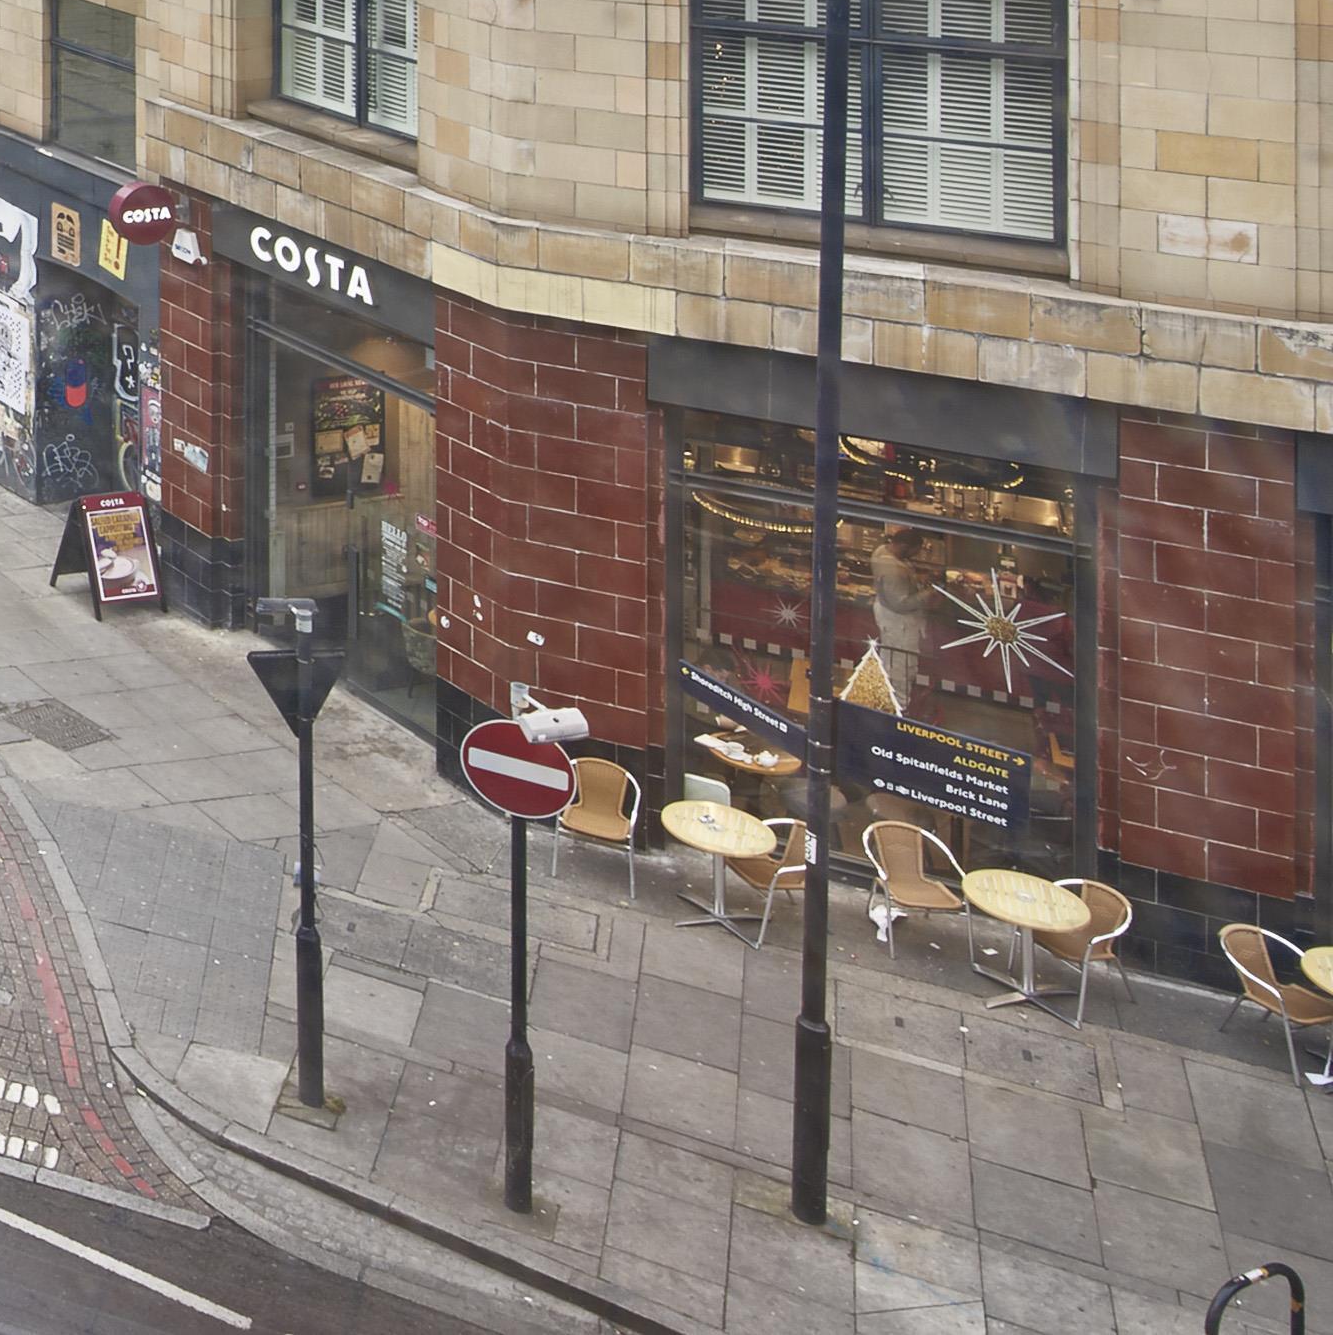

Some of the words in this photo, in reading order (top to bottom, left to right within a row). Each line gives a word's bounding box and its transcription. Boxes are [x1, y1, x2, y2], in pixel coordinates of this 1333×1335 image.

[122, 206, 171, 223] COSTA
[250, 226, 374, 306] COSTA
[100, 498, 125, 507] COSTA
[691, 671, 733, 701] Shoreditch
[734, 696, 753, 713] High
[753, 707, 779, 729] Street
[896, 721, 963, 749] LIVERPOOL
[965, 741, 1010, 763] STREET
[871, 745, 893, 760] Old
[895, 753, 963, 782] Spitalfields
[966, 774, 1009, 795] Market
[953, 754, 1010, 779] ALDGATE
[911, 788, 967, 815] Liverpool
[969, 807, 1008, 828] Street
[945, 783, 976, 801] Brick
[978, 795, 1008, 811] Lane
